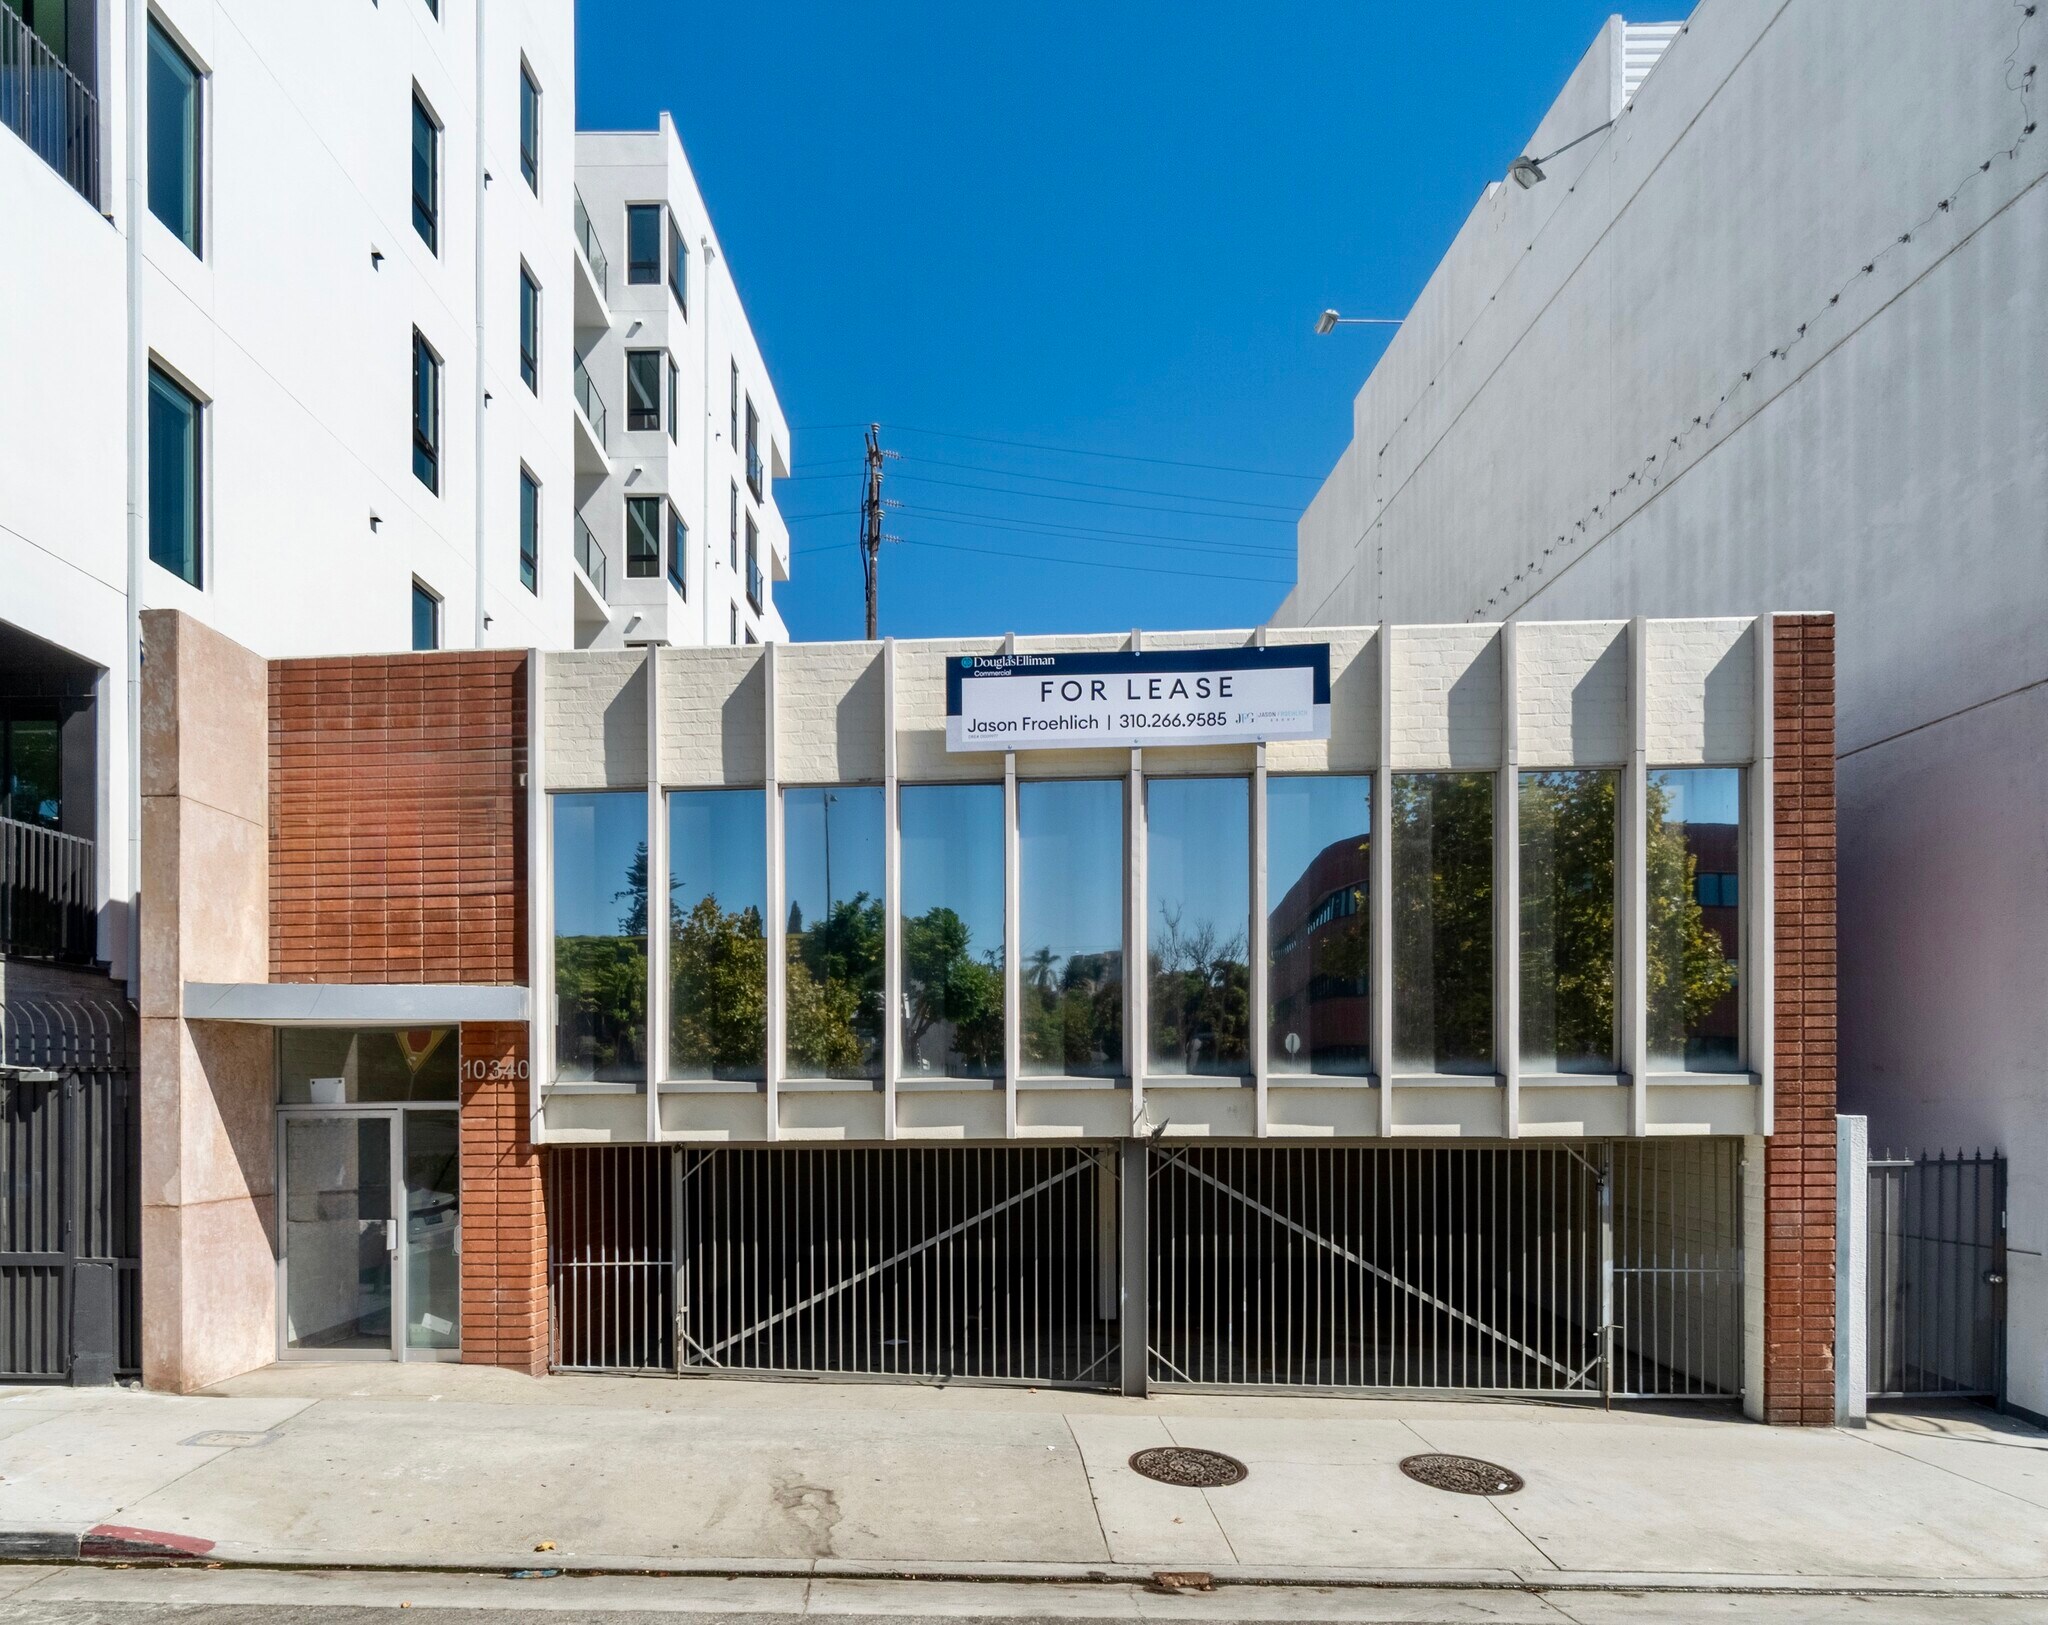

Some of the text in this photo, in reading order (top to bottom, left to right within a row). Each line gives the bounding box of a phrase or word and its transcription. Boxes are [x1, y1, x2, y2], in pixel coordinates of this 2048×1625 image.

[1041, 676, 1233, 702] FOR LEASE
[967, 718, 1017, 733] Jason
[1022, 714, 1099, 731] Froehlich
[1119, 712, 1227, 728] 310.266.9585
[463, 1059, 530, 1080] 10340
